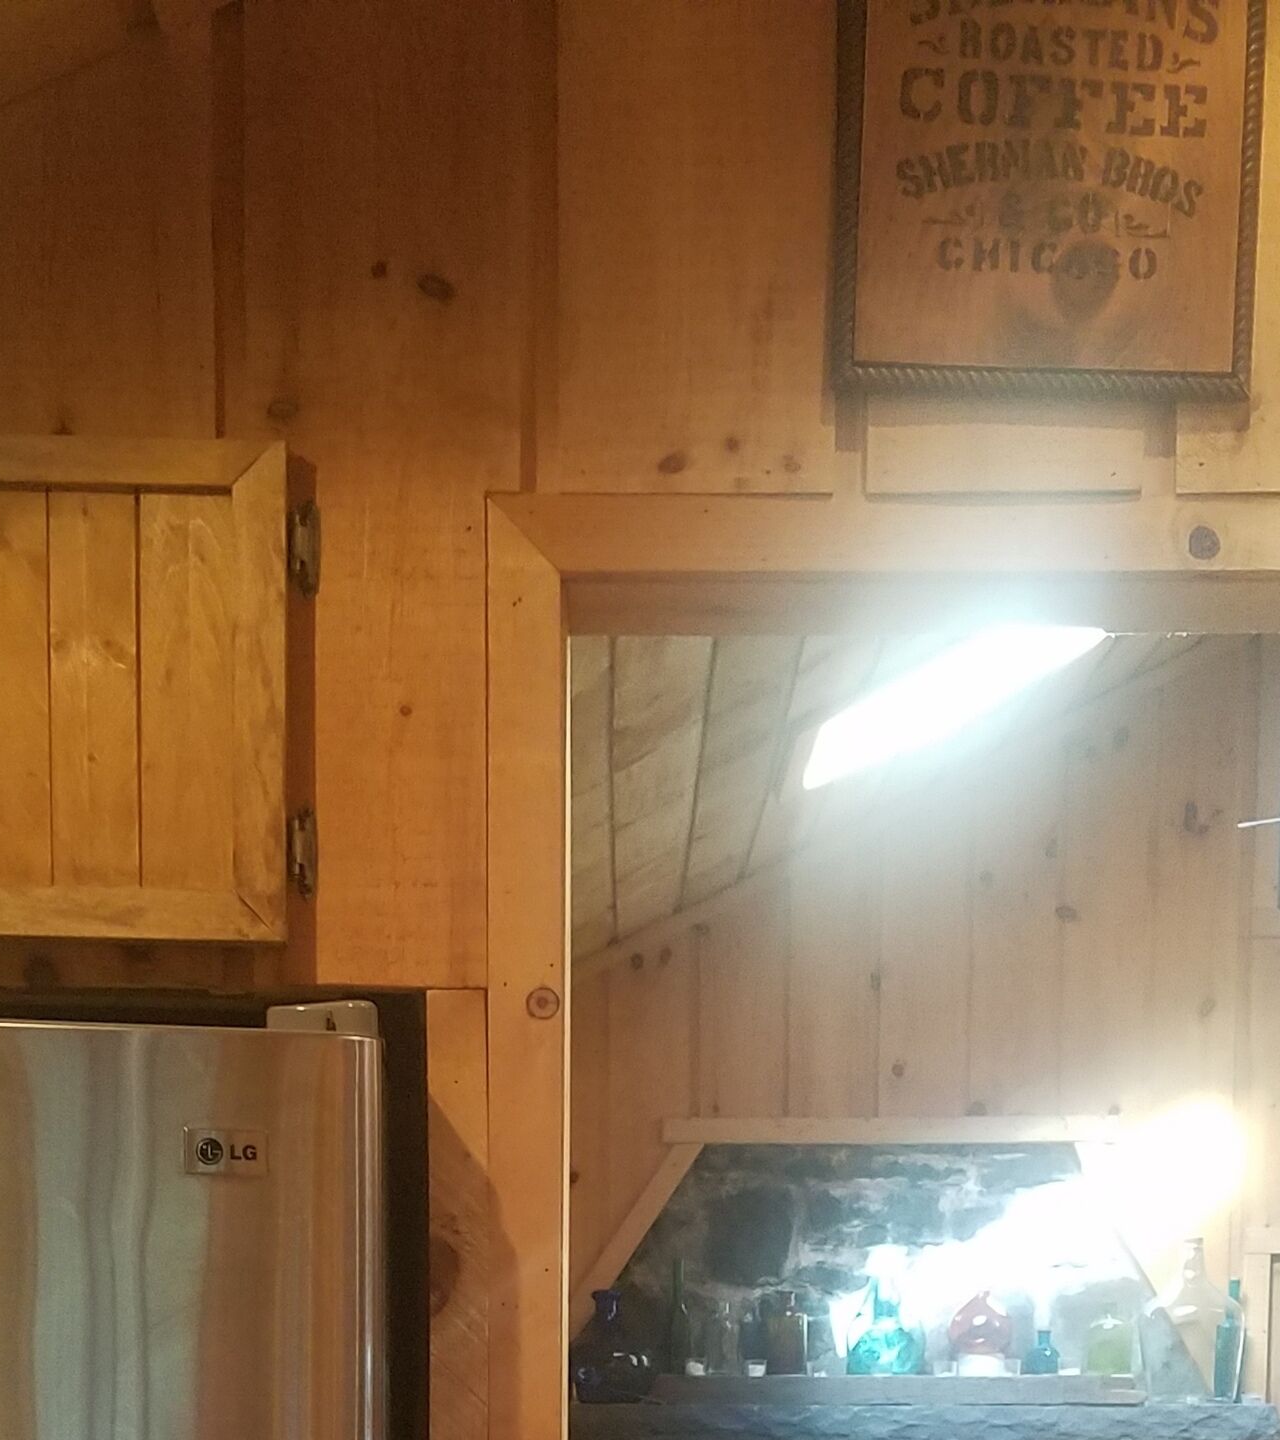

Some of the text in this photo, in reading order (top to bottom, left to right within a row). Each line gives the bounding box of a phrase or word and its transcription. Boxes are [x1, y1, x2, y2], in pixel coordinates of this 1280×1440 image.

[958, 17, 1164, 73] ROASTED
[898, 67, 1209, 139] COFFEE
[895, 138, 1204, 219] SHERMAN BROS
[936, 237, 1158, 281] CHICO
[229, 1144, 258, 1161] LG
